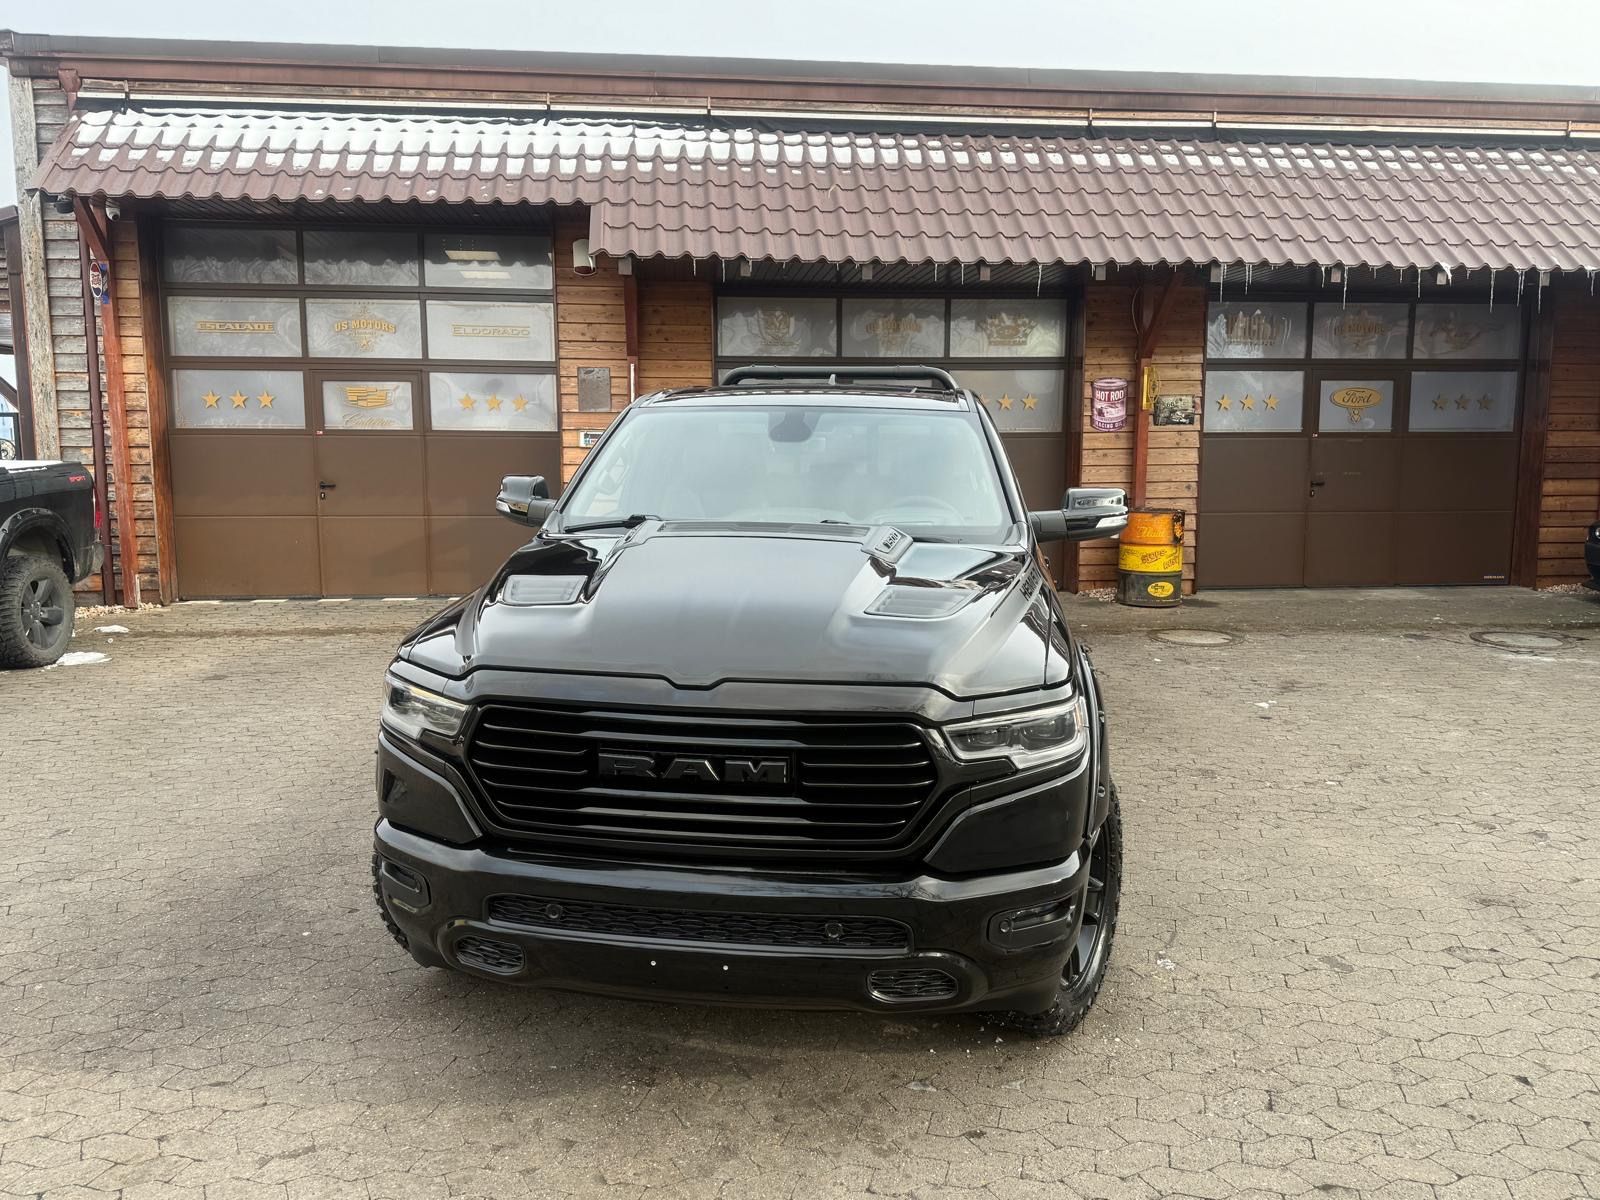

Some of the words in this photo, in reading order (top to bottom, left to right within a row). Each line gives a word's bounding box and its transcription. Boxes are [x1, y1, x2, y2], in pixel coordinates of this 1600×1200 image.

[198, 322, 274, 331] ESCALADE
[335, 321, 348, 333] US
[351, 319, 397, 334] MOTORS
[453, 326, 530, 337] ELDORADO
[1096, 390, 1109, 401] HOT
[1110, 390, 1124, 401] ROD
[1342, 389, 1372, 404] Ford
[598, 753, 787, 784] RAM
